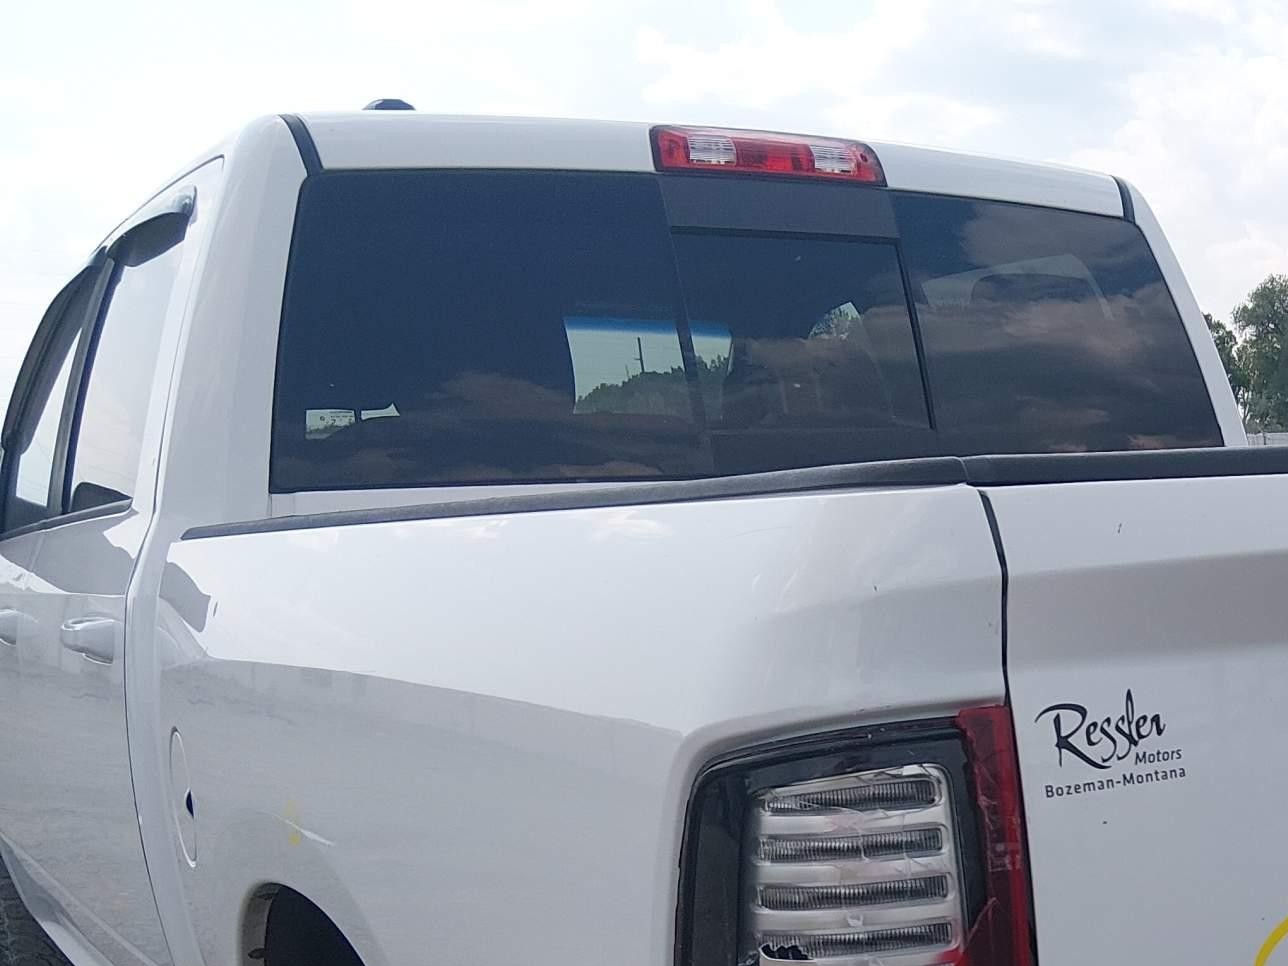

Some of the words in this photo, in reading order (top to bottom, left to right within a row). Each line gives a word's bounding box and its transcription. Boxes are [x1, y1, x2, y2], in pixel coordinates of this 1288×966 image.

[1034, 688, 1166, 770] Ressler
[1134, 748, 1182, 766] Motors
[1045, 767, 1187, 799] Bozeman-Montana
